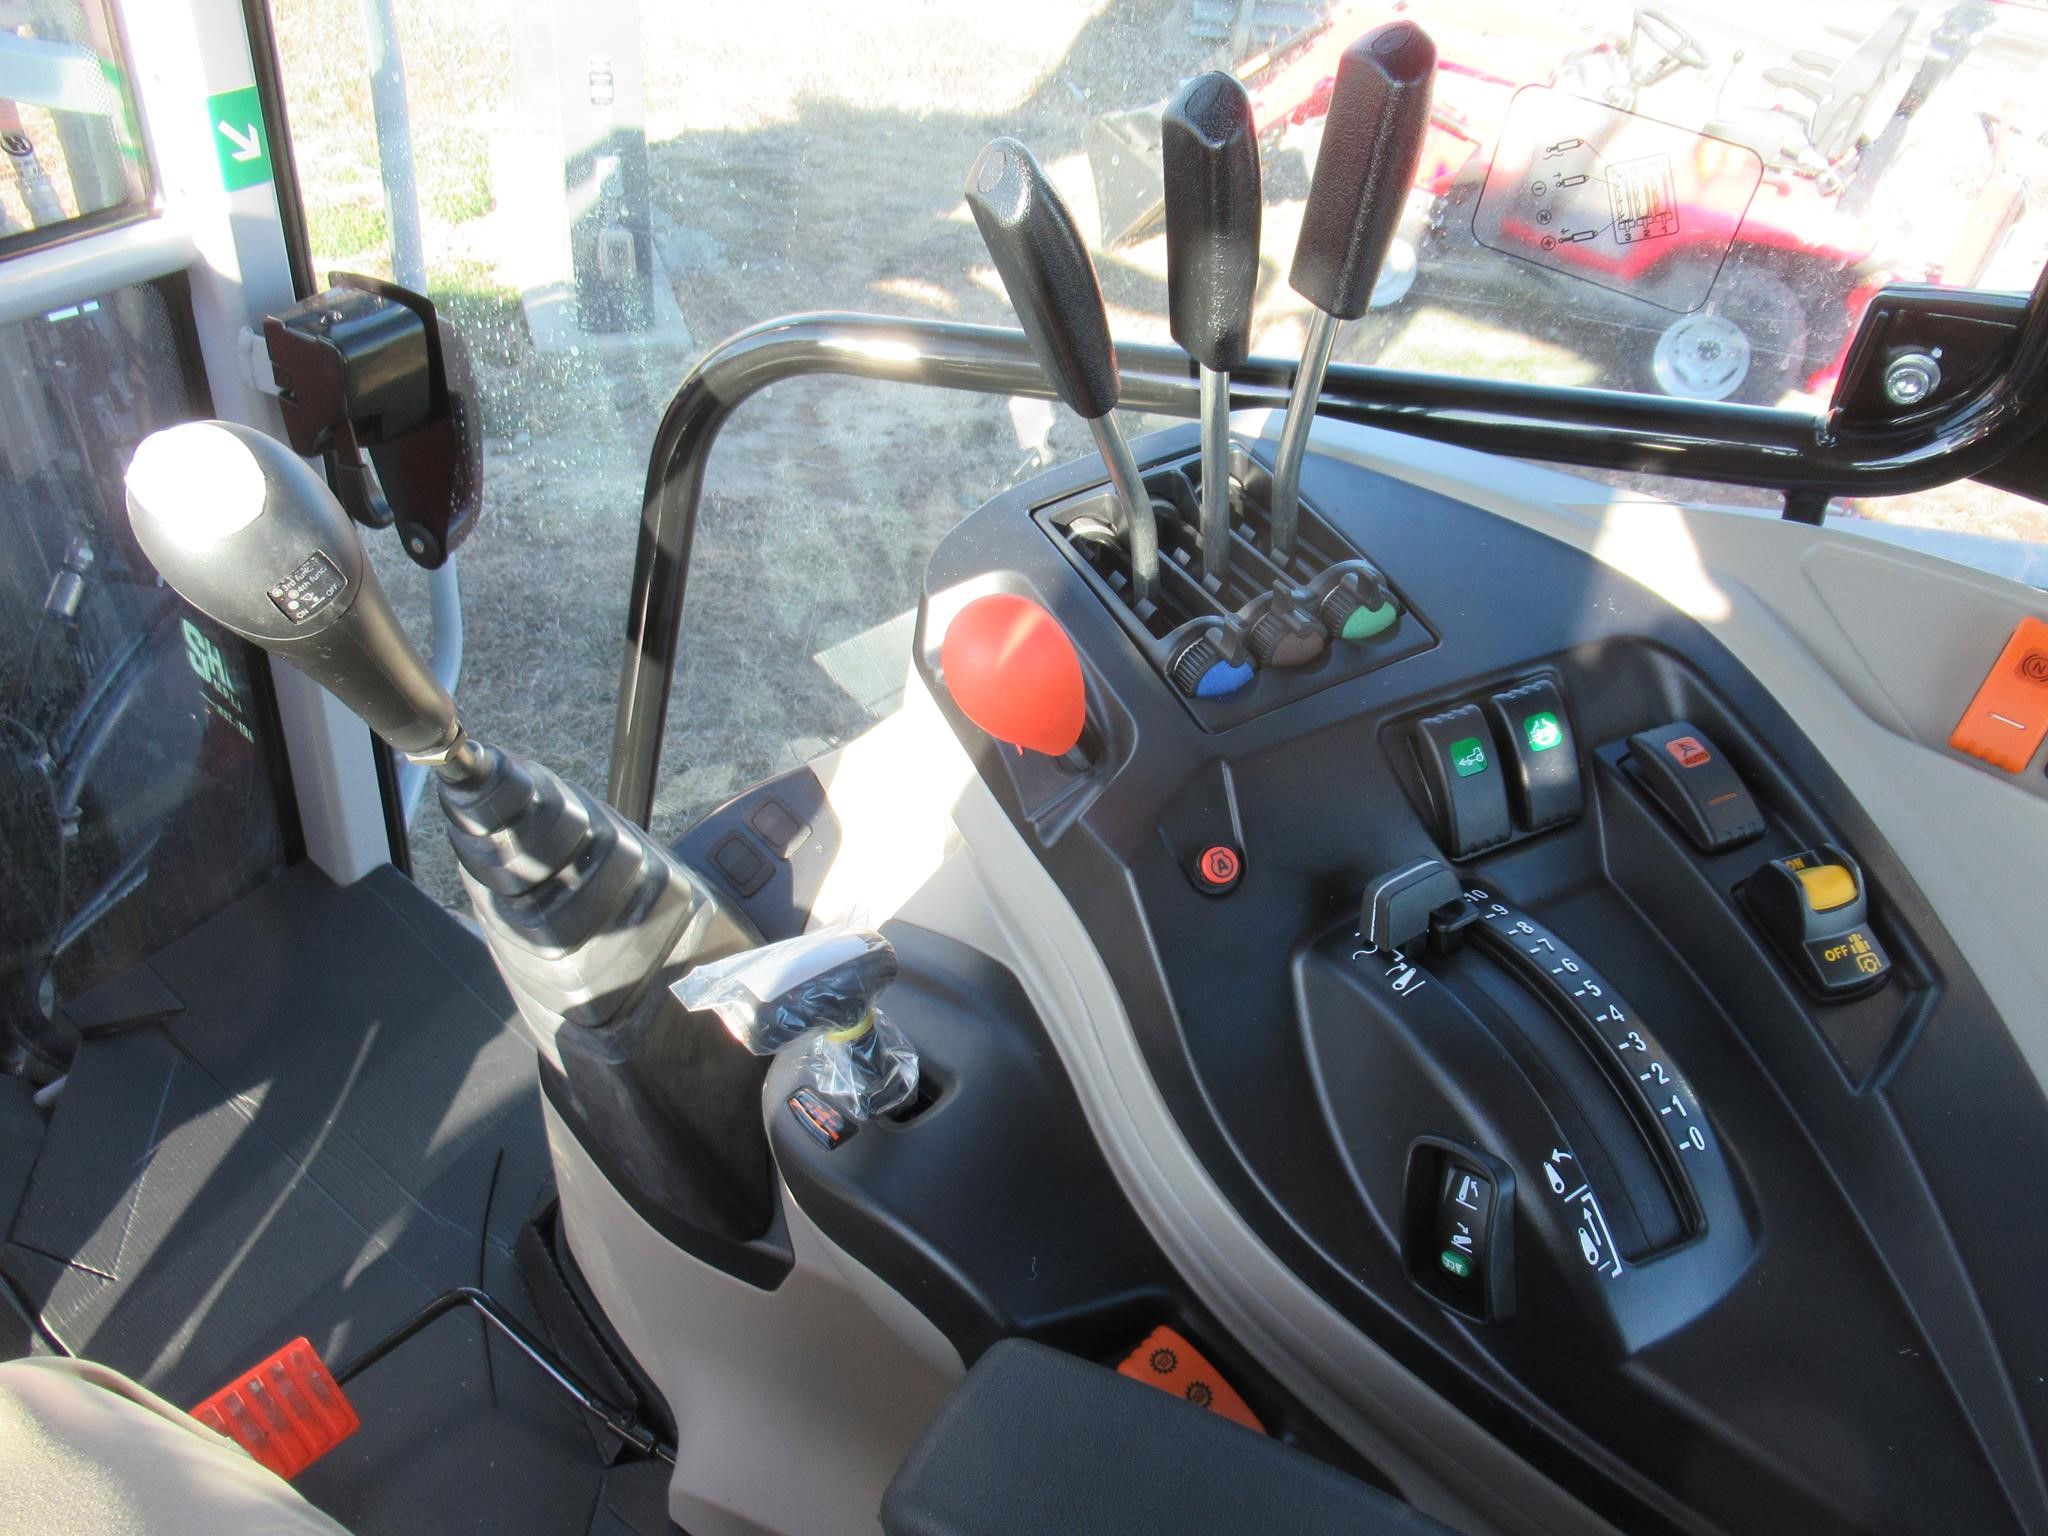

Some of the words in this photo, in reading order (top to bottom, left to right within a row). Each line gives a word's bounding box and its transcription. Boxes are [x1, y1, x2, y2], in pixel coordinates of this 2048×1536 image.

[1625, 233, 1632, 241] 3
[1643, 229, 1650, 237] 2
[282, 575, 296, 591] 3rd
[298, 580, 311, 592] 4th
[296, 608, 309, 619] ON
[326, 583, 339, 597] OFF
[1218, 859, 1229, 873] A
[1785, 857, 1805, 870] ON
[1464, 889, 1489, 902] 10
[1491, 904, 1509, 915] 9
[1516, 921, 1535, 934] 8
[1537, 938, 1555, 951] 7
[1824, 944, 1849, 962] OFF
[1561, 958, 1579, 972] 6
[1583, 979, 1602, 997] 5
[1609, 1004, 1625, 1022] 4
[1628, 1031, 1647, 1051] 3
[1651, 1062, 1671, 1085] 2
[1672, 1095, 1687, 1117] 1
[1689, 1126, 1705, 1151] 0
